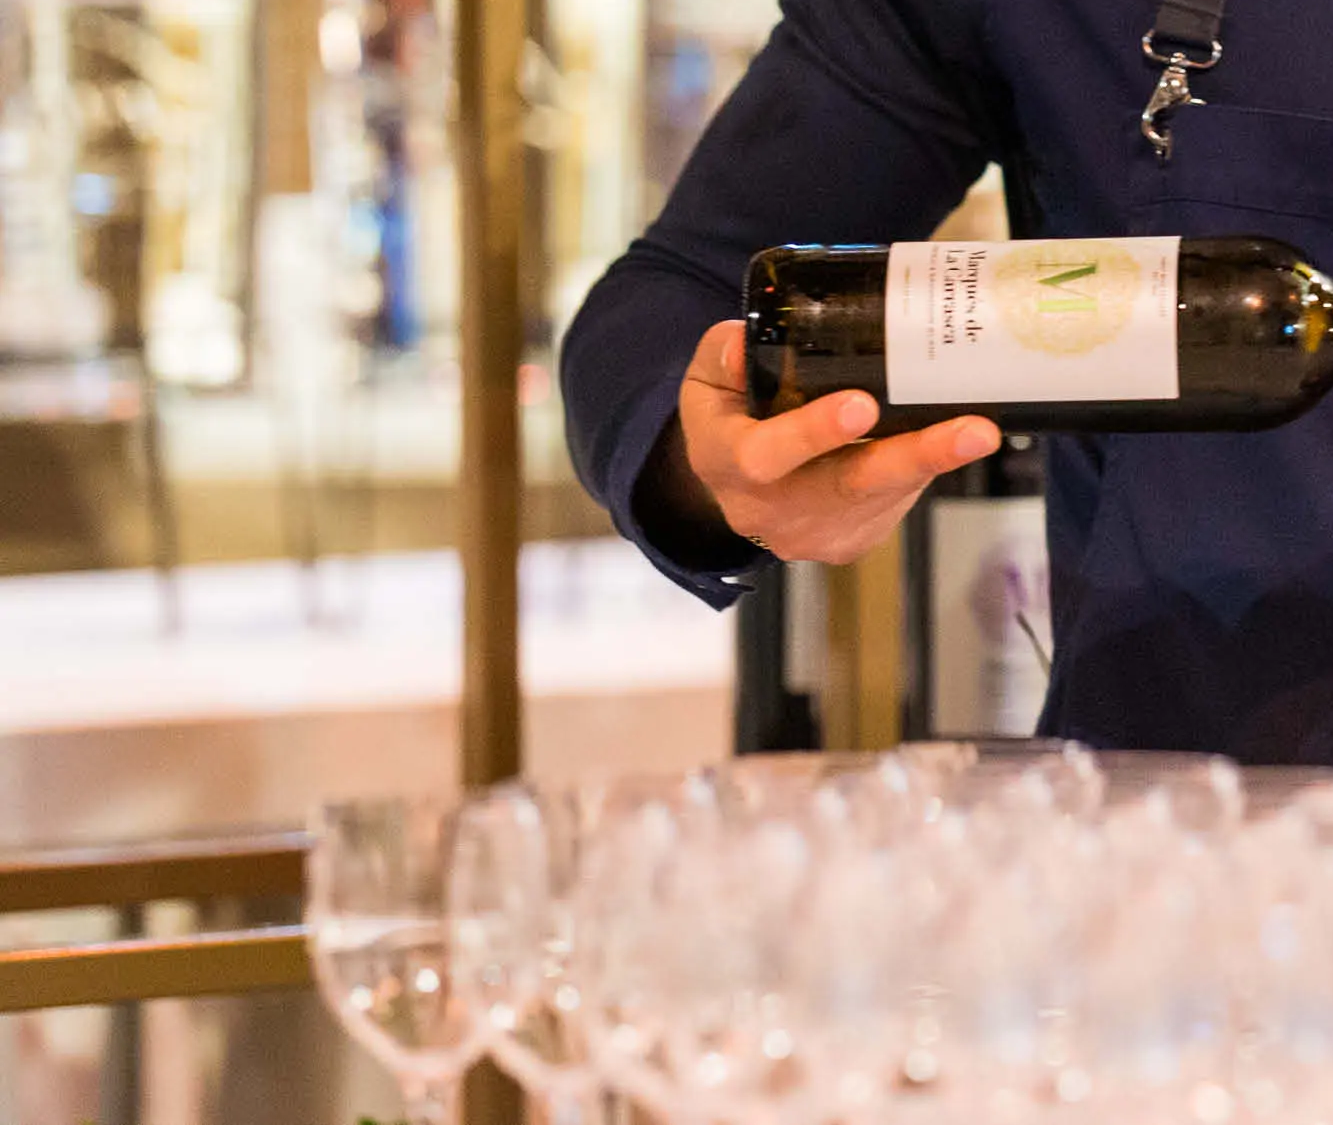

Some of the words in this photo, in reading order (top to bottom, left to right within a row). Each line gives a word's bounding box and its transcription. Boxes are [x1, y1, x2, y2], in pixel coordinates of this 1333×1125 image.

[945, 249, 965, 263] La
[1034, 259, 1098, 313] M
[965, 318, 984, 343] de
